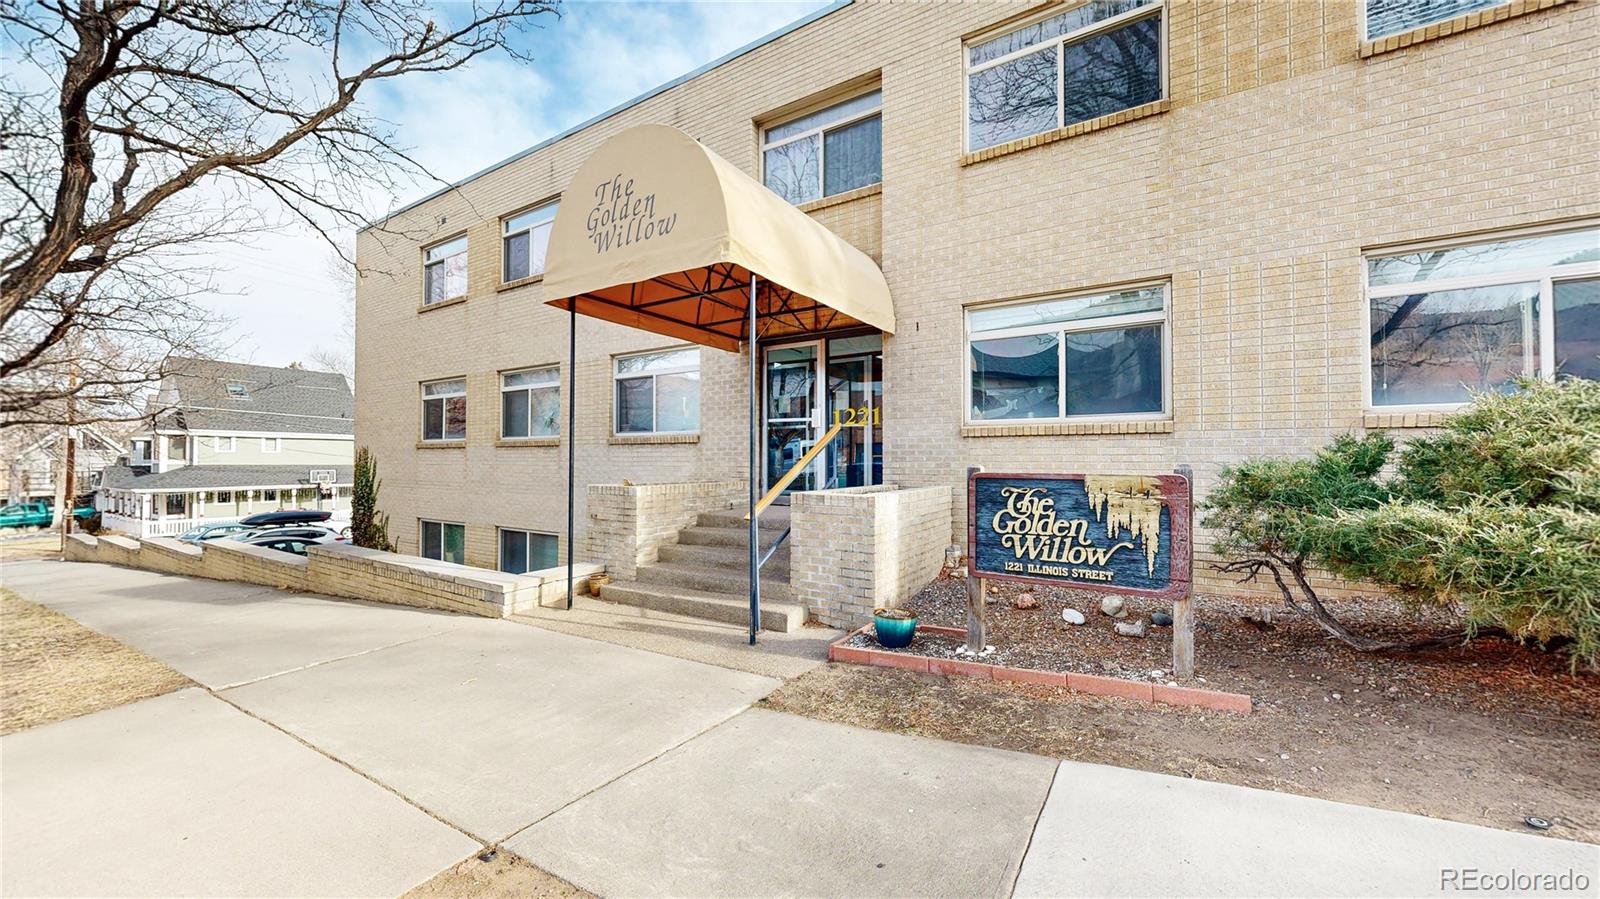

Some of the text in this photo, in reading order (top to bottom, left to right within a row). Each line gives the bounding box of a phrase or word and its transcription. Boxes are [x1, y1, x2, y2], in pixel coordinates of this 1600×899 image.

[594, 173, 634, 206] The
[587, 193, 655, 239] Golden
[594, 213, 677, 254] Willow
[833, 406, 881, 426] 1221
[1001, 487, 1054, 518] The
[992, 508, 1092, 545] Golden
[1001, 534, 1135, 566] Willow
[1004, 561, 1114, 581] 1221 ILLINOIS STREET
